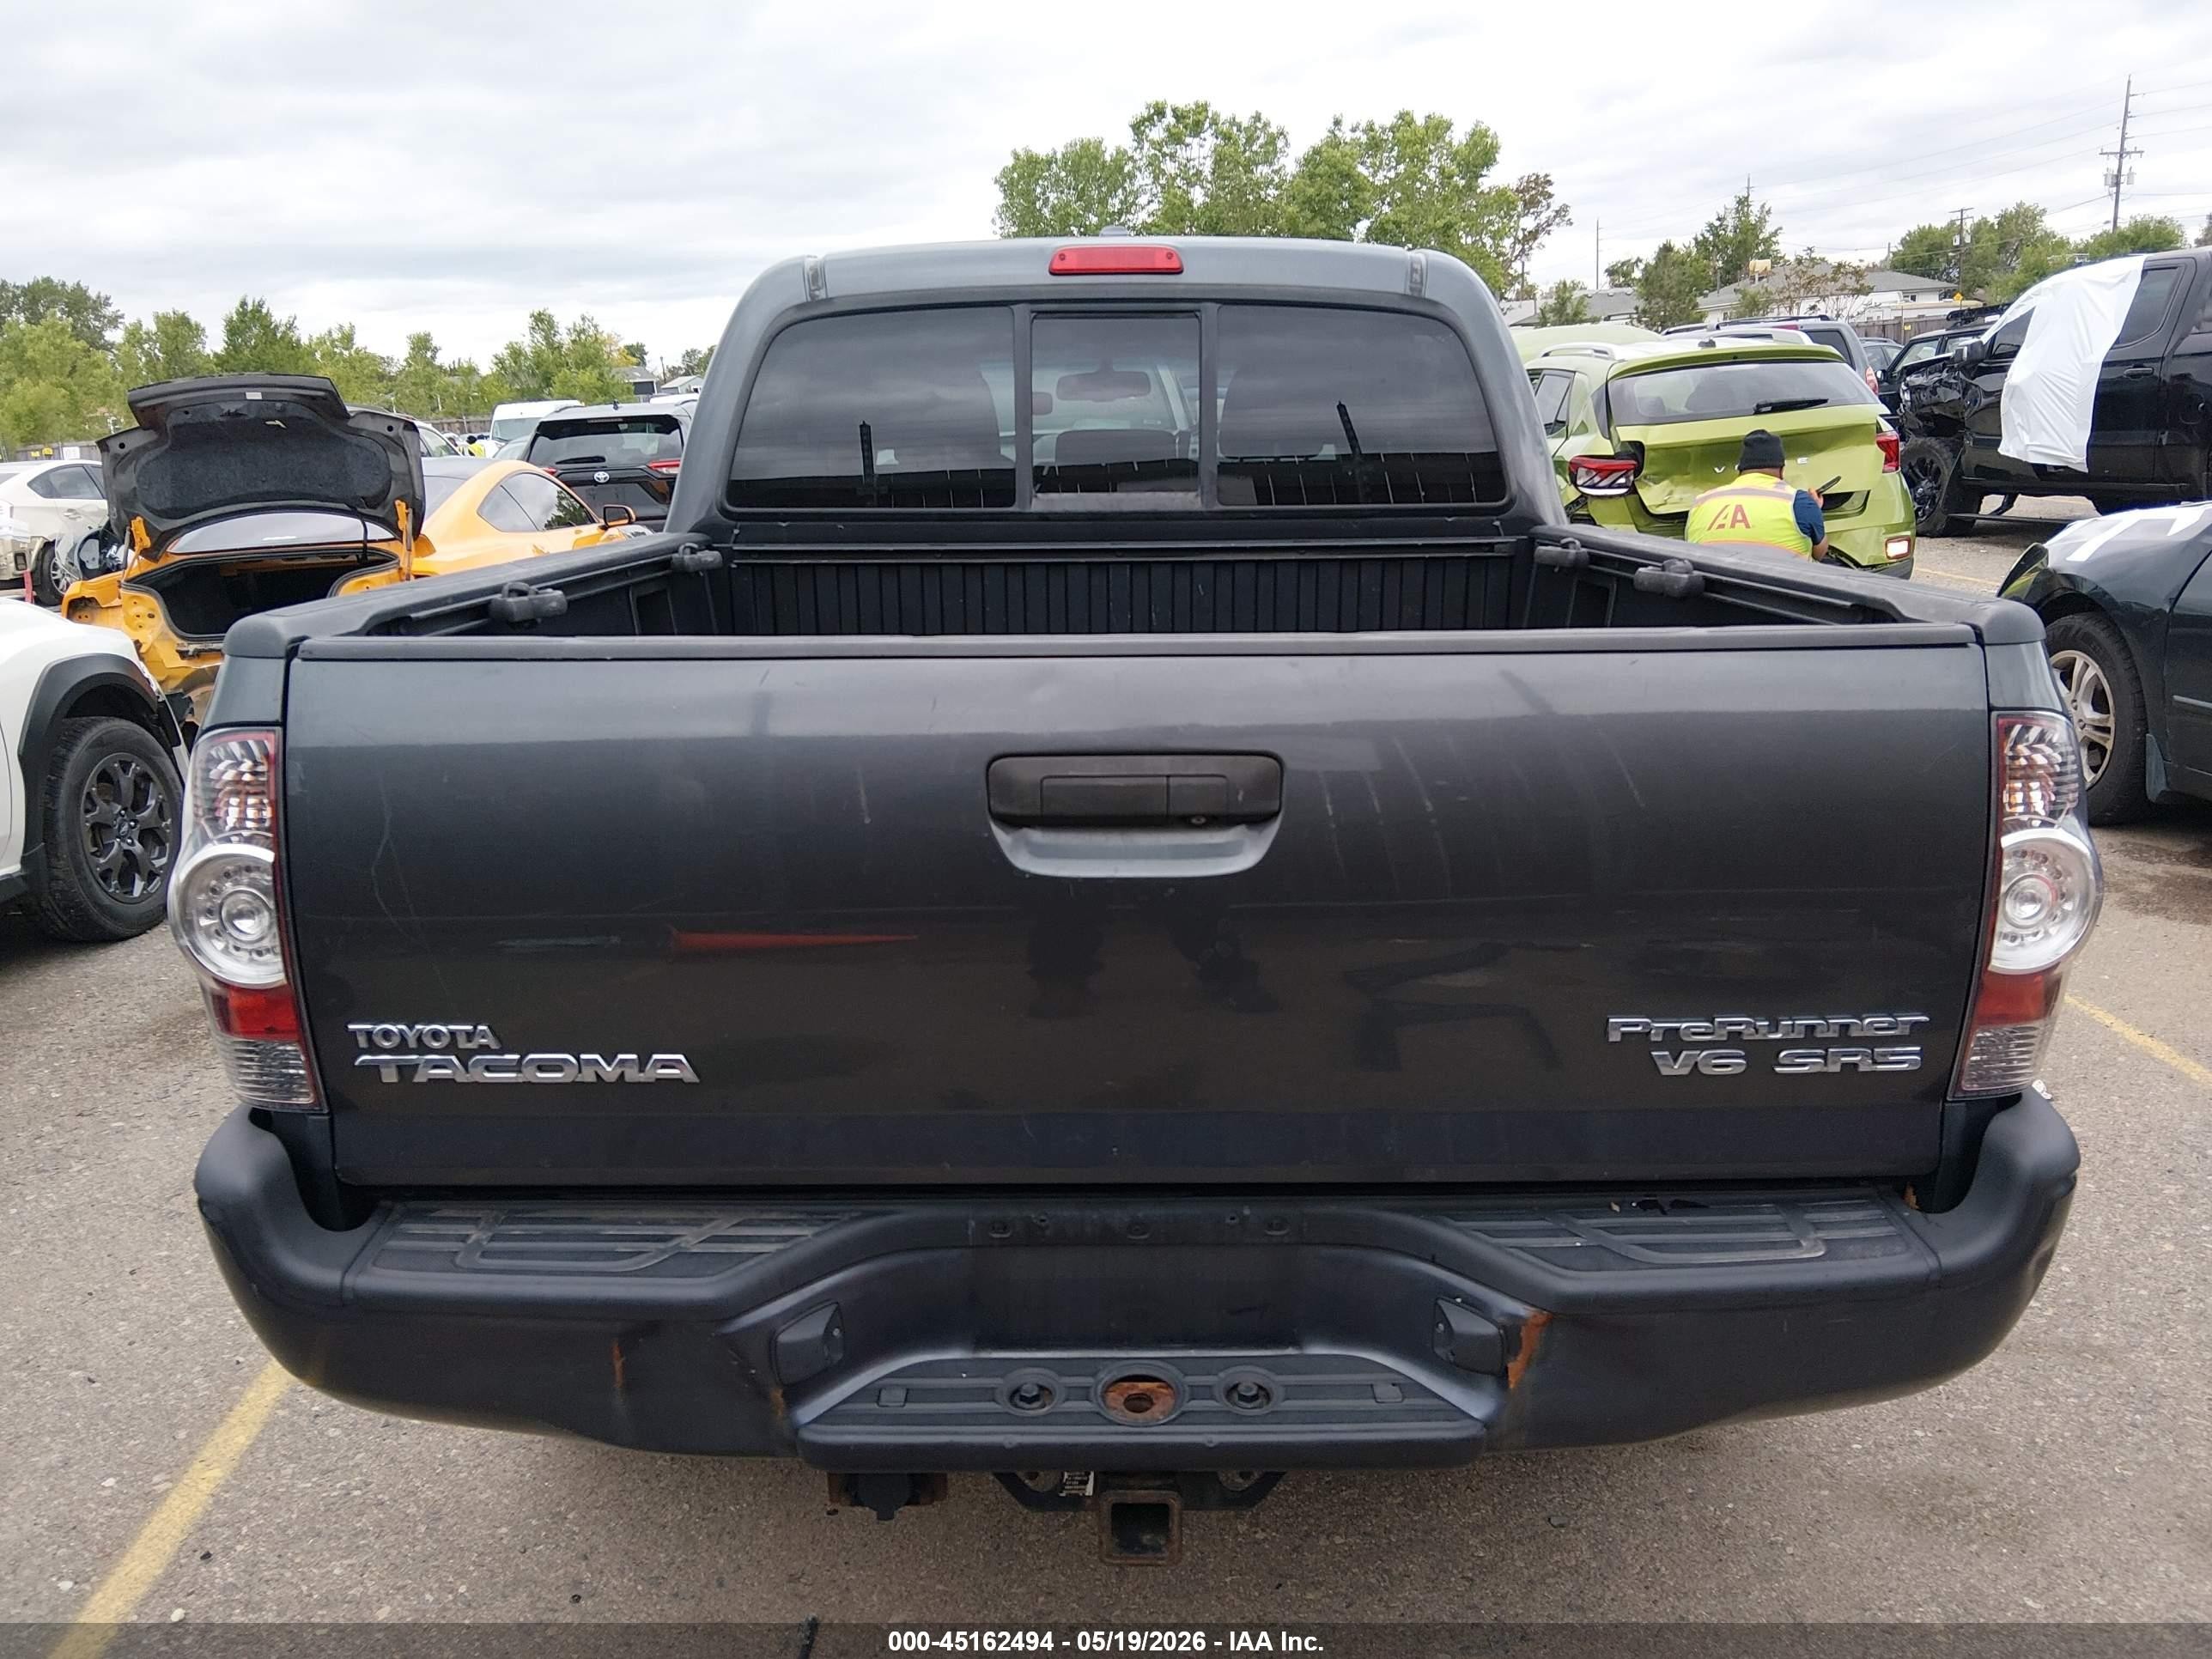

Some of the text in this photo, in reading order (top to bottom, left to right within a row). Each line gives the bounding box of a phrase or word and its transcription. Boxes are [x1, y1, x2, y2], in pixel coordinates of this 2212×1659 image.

[347, 1024, 502, 1049] TOYOTA
[1607, 1014, 1931, 1042] PreRunner
[354, 1053, 701, 1084] TACOMA
[1650, 1046, 1922, 1076] V6 SR5
